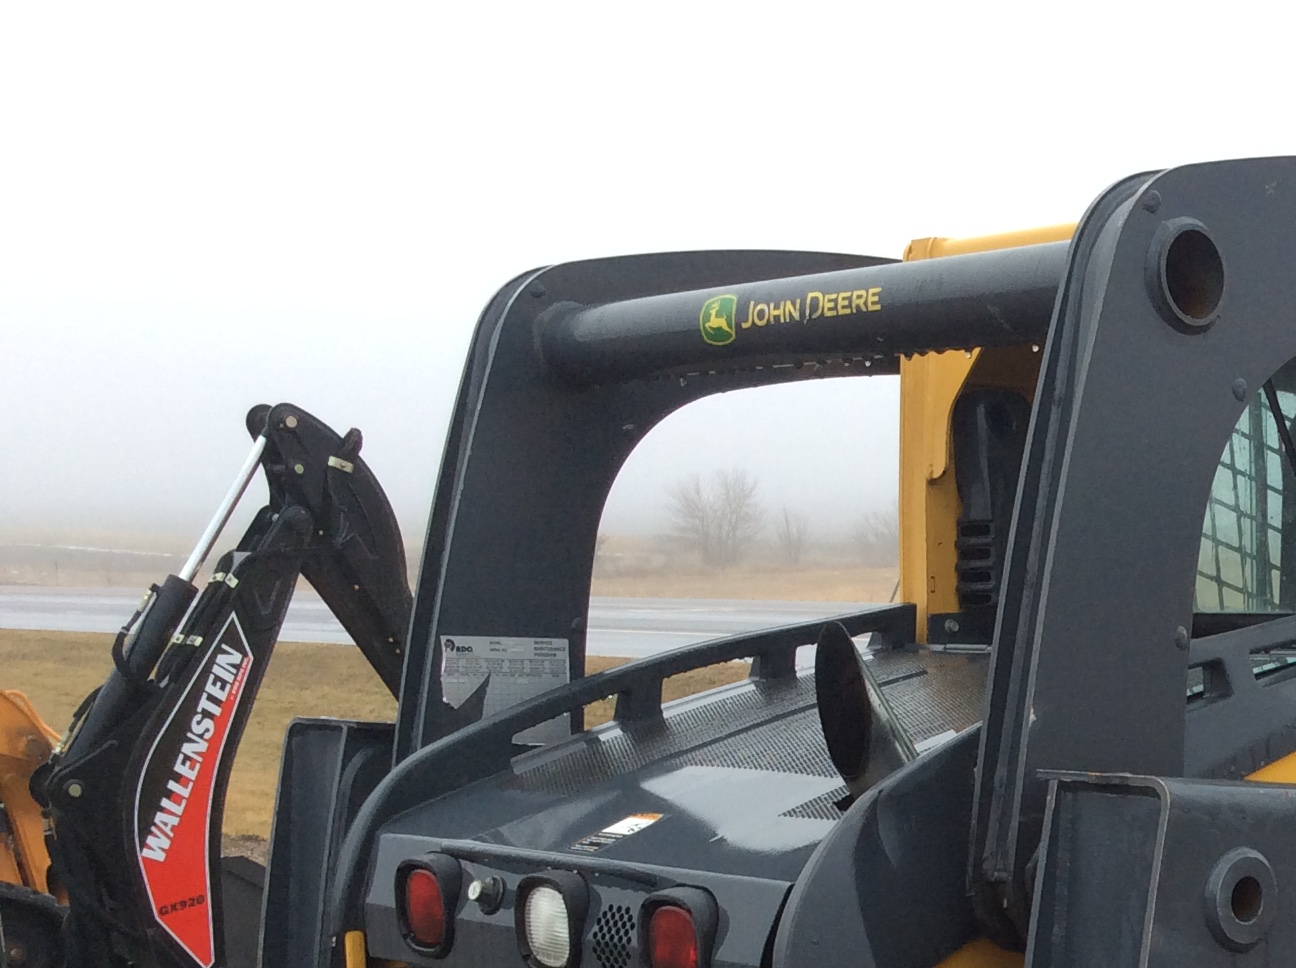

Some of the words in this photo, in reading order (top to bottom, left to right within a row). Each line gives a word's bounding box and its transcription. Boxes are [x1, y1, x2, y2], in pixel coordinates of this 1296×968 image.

[741, 299, 801, 330] JOHN
[804, 287, 883, 325] DEERE
[141, 644, 244, 863] WALLENSTEIN
